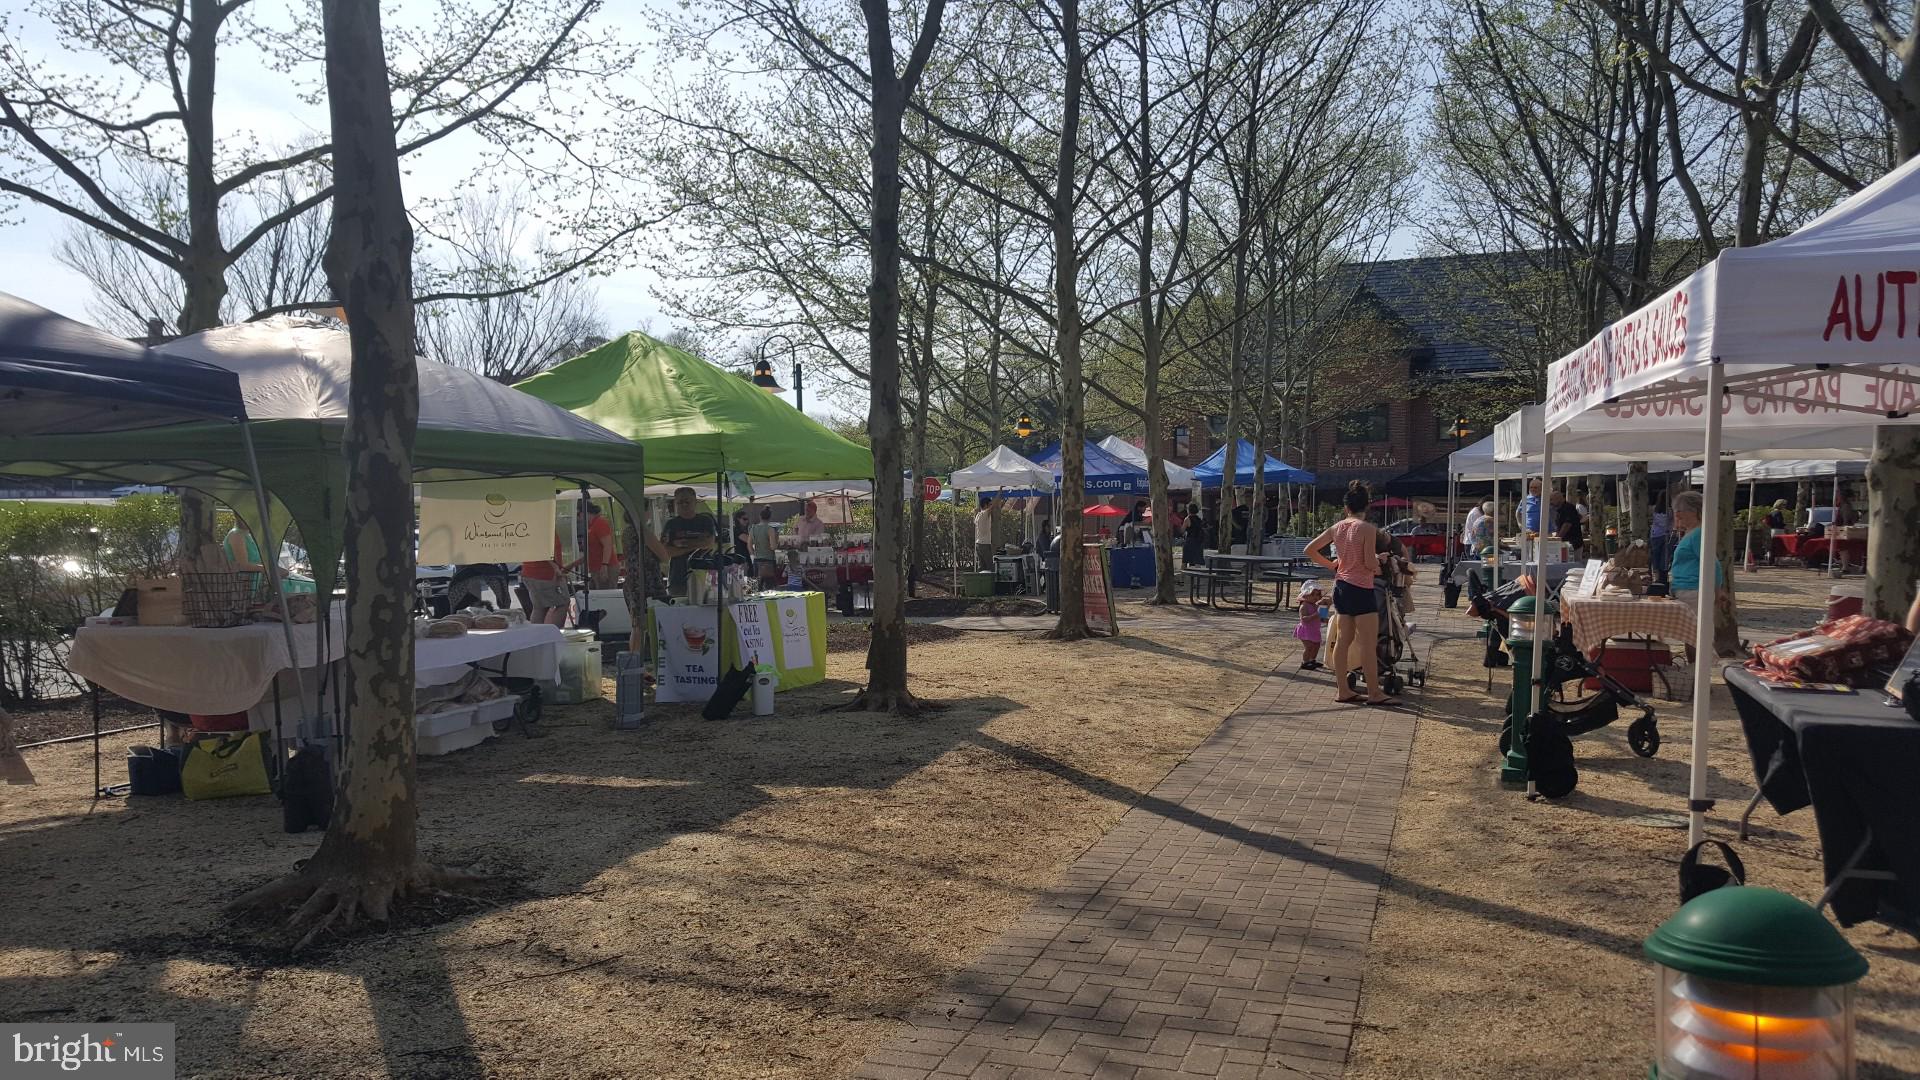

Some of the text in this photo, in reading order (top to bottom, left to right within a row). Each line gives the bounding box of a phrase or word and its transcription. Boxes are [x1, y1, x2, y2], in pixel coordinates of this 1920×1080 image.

[1823, 271, 1920, 343] AUT
[1613, 317, 1641, 382] PASTAS
[1651, 290, 1688, 366] SAUCES
[1329, 457, 1396, 468] SUBURBAN
[926, 484, 940, 495] TOP
[738, 604, 759, 623] FREE
[685, 664, 704, 673] TEA
